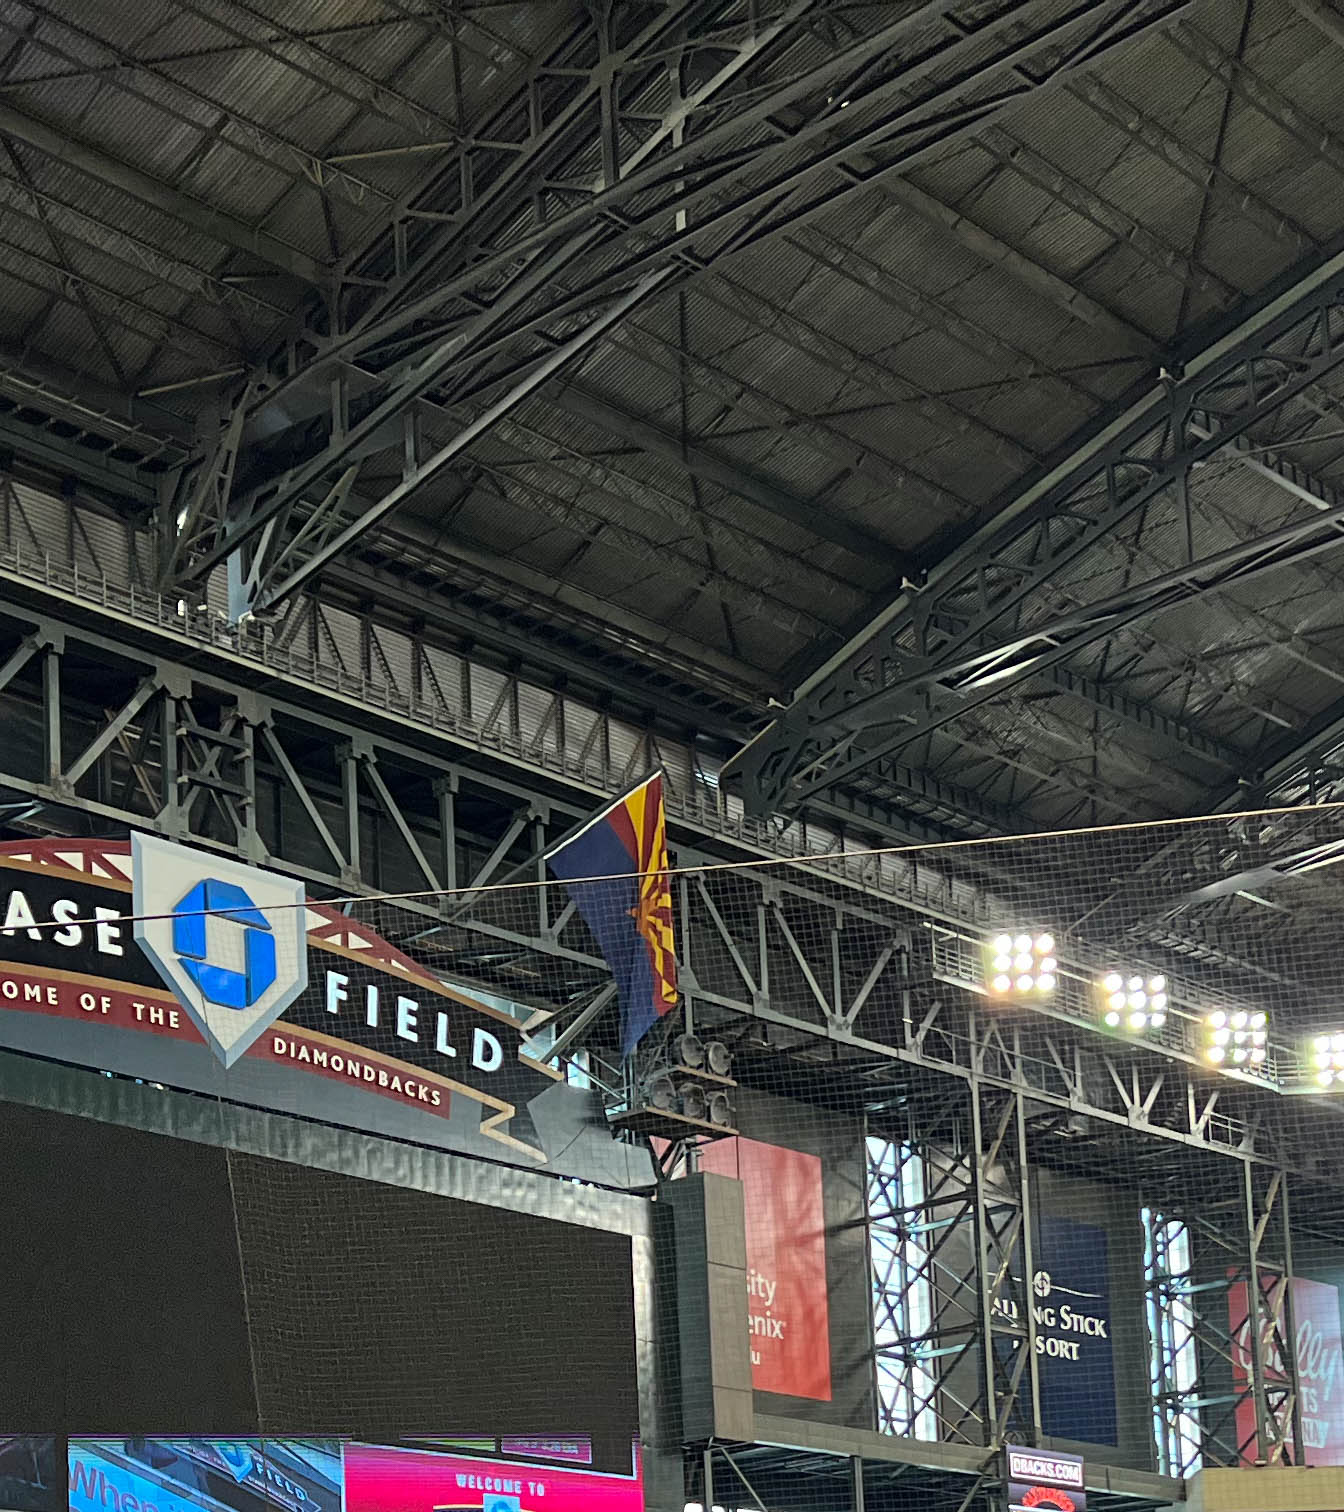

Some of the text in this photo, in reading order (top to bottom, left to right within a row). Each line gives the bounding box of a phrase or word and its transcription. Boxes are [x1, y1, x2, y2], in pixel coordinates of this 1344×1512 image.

[80, 992, 114, 1016] OF
[132, 1002, 182, 1031] THE
[272, 1035, 444, 1108] DIAMONDBACKS
[324, 967, 504, 1075] FIELD
[456, 1474, 545, 1497] WELCOME TO
[1013, 1458, 1079, 1483] DBACKS.COM
